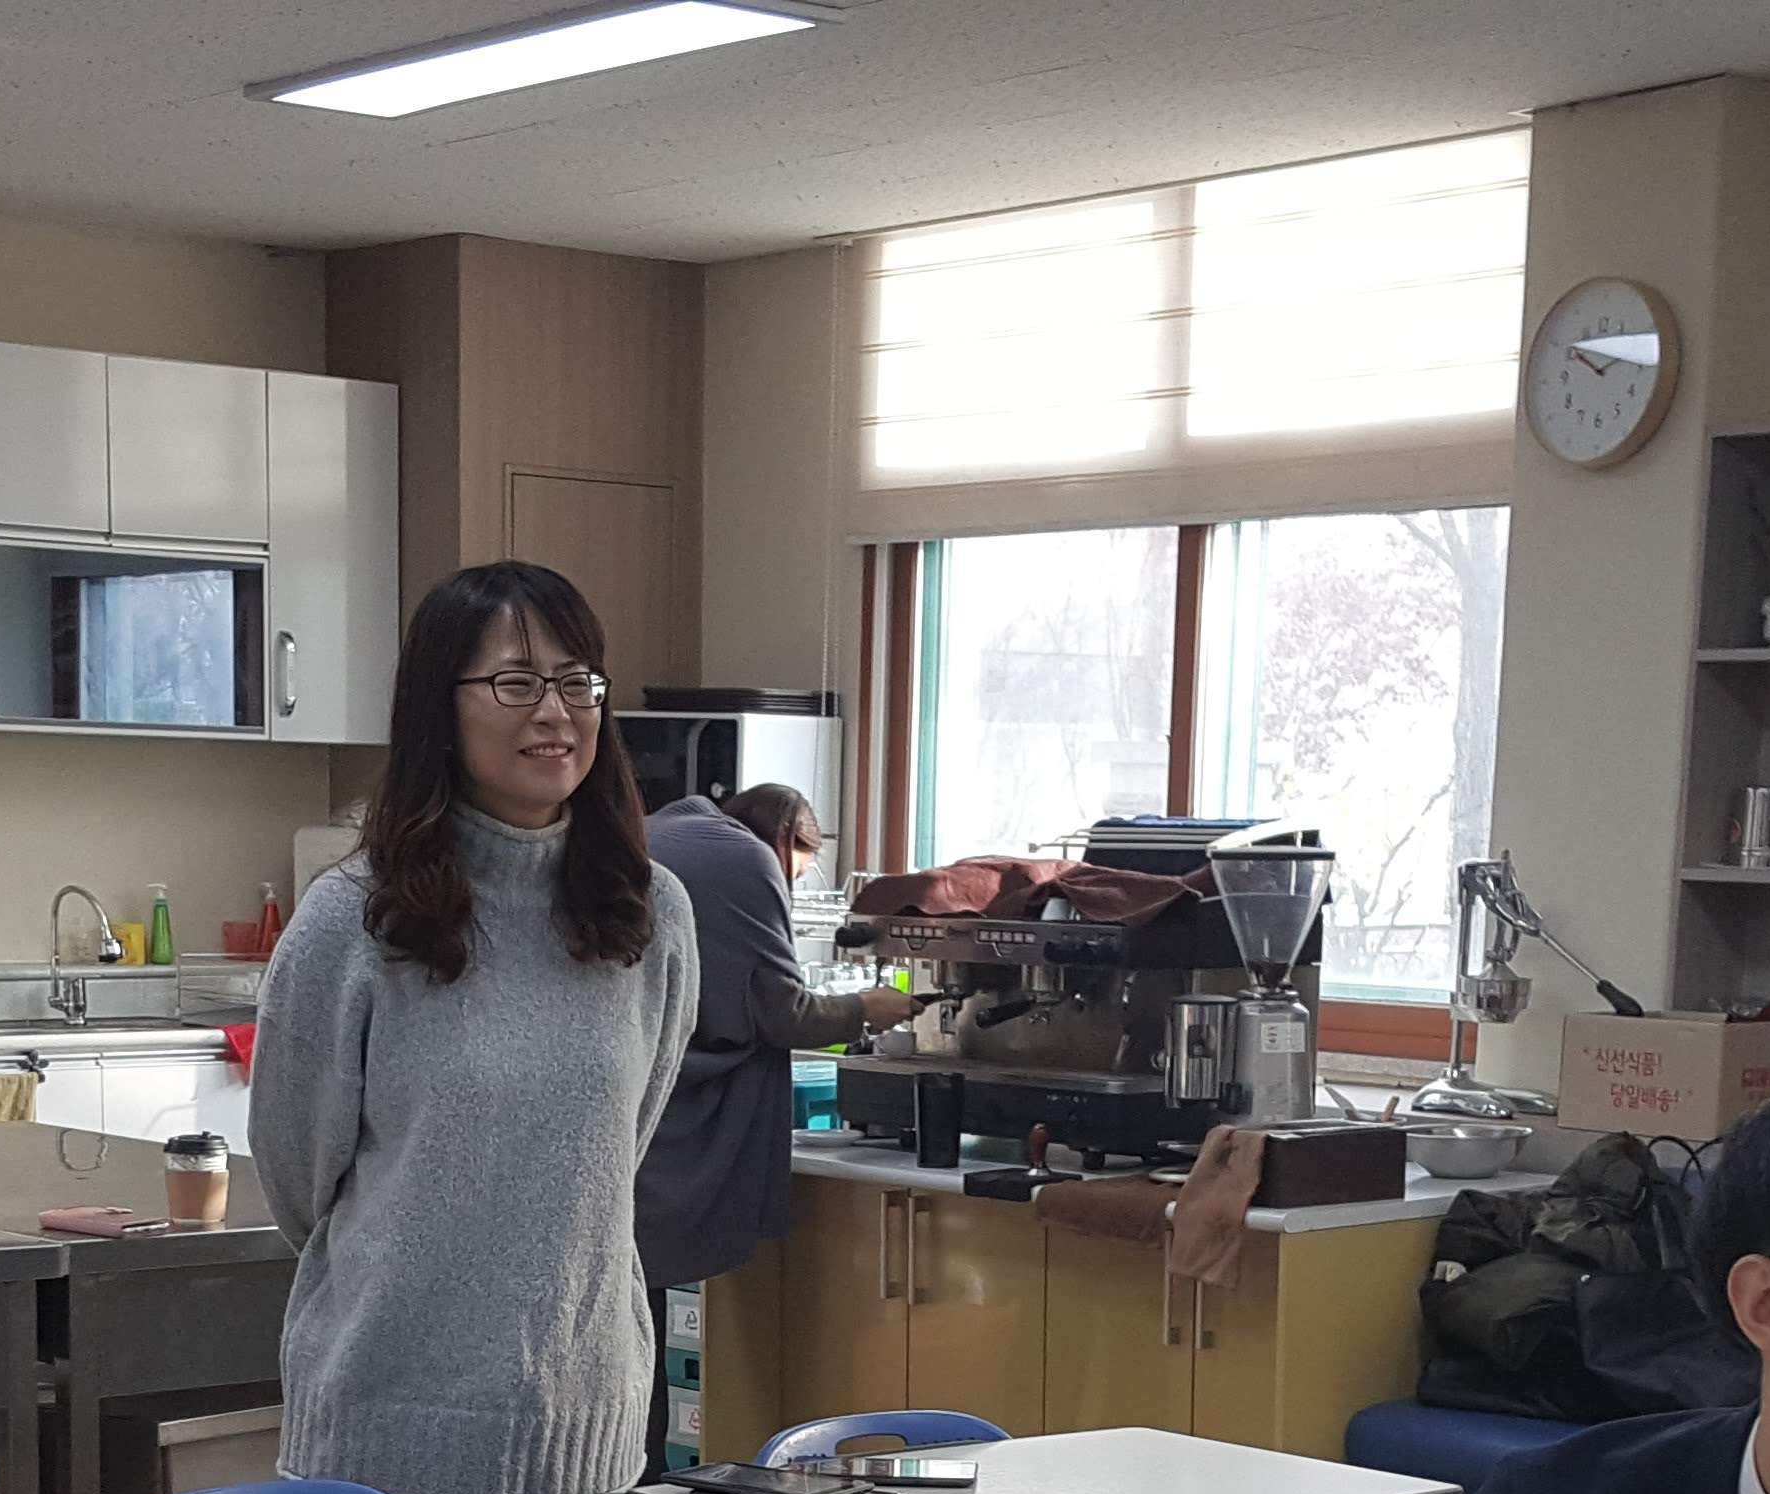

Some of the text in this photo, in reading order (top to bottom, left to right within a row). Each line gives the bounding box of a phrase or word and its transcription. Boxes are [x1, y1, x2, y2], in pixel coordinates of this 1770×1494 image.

[1564, 393, 1573, 410] 8
[1613, 402, 1621, 418] 5
[1576, 408, 1586, 424] 7
[1594, 412, 1603, 429] 6
[1595, 1047, 1662, 1077] 신선식품!
[1609, 1081, 1680, 1114] 당일배송!
